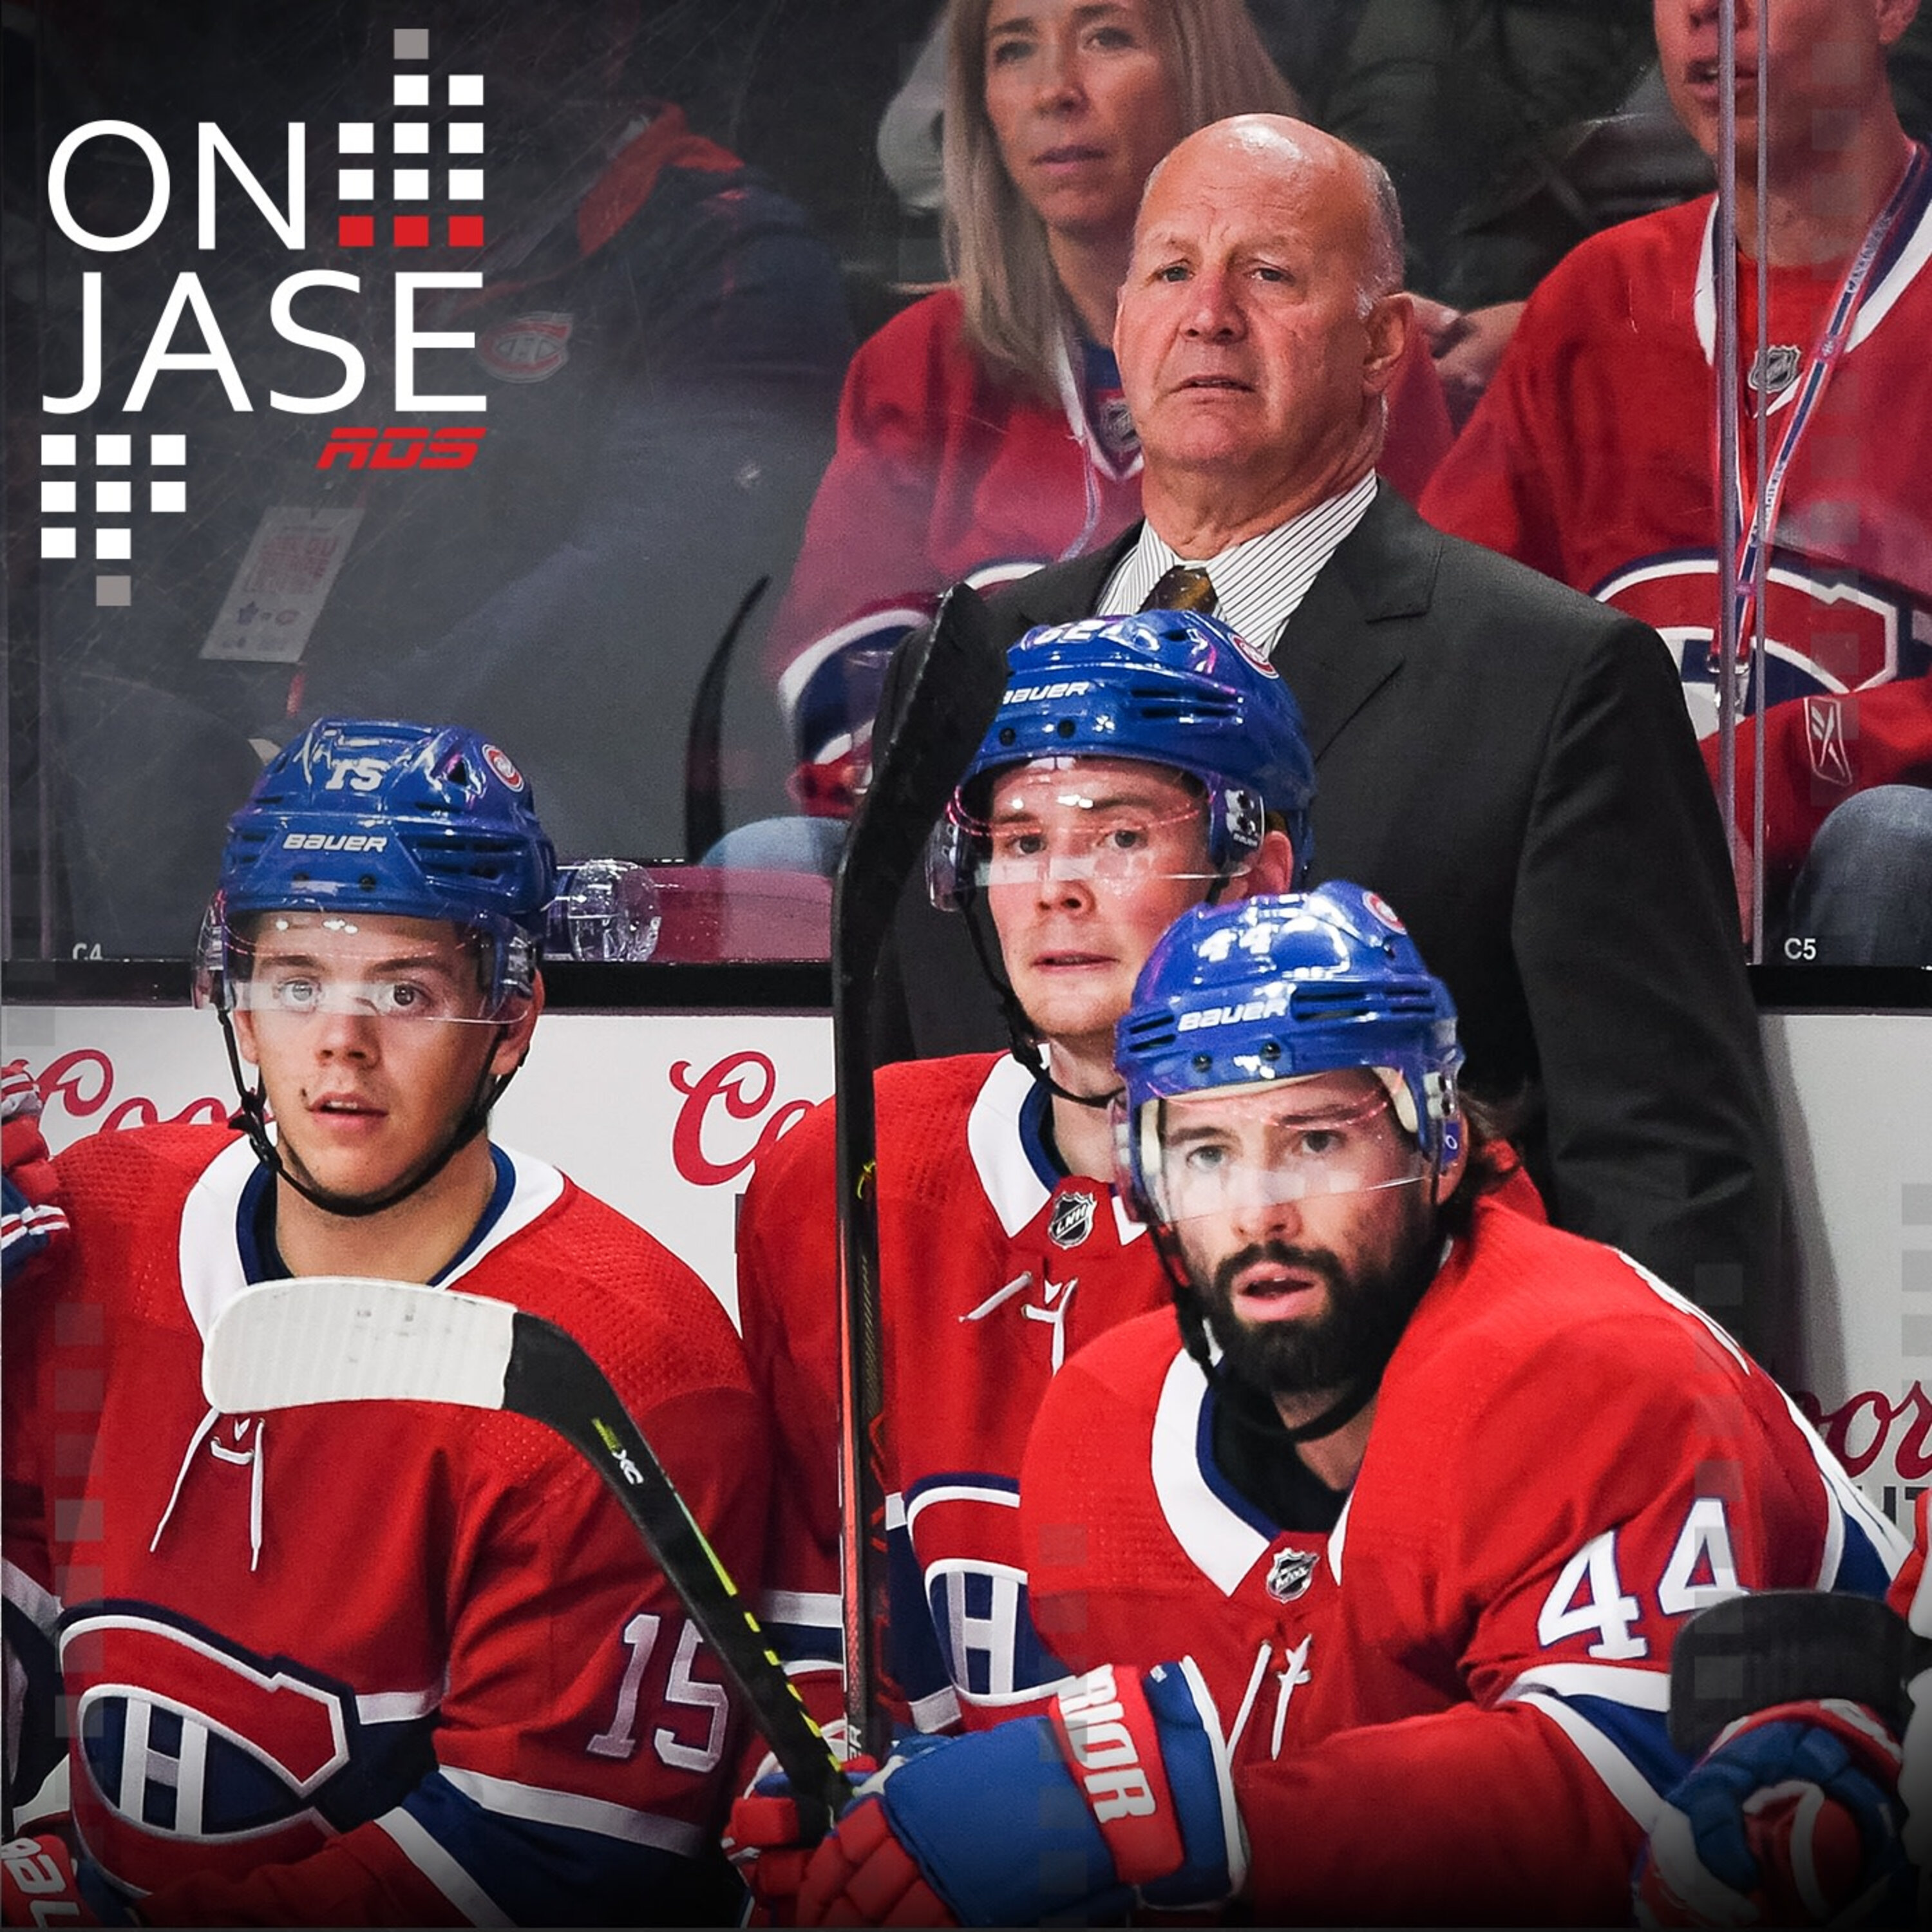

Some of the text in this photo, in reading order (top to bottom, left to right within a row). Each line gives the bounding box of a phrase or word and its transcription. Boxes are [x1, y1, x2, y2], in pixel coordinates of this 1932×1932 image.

[325, 757, 392, 791] 15
[283, 833, 388, 853] BAUER
[72, 942, 103, 960] C4
[1784, 937, 1817, 960] C5
[1177, 998, 1289, 1032] BAUER
[1537, 1499, 1750, 1660] 44
[587, 1613, 729, 1773] 15
